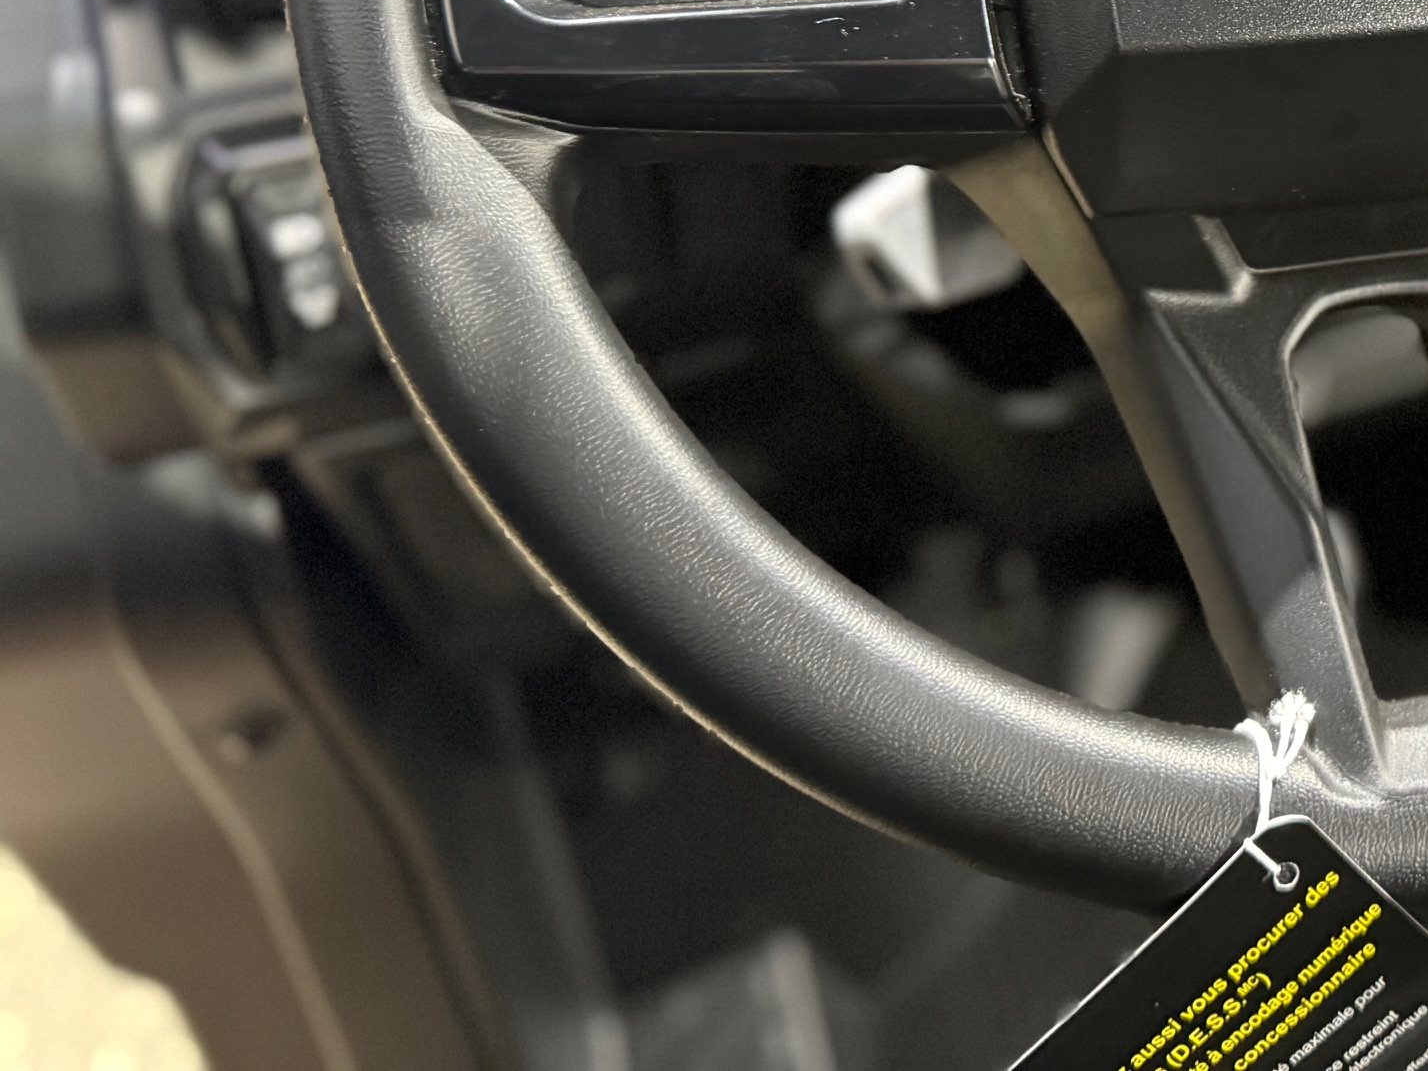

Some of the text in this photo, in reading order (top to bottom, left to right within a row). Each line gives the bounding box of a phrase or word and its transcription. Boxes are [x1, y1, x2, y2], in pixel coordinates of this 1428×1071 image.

[1130, 870, 1339, 1070] aussi vous procurer des
[1206, 903, 1382, 1065] à encodage numérique
[1234, 943, 1376, 1071] concessionnaire
[1289, 975, 1387, 1067] maximale pour
[1343, 1009, 1400, 1063] restreint
